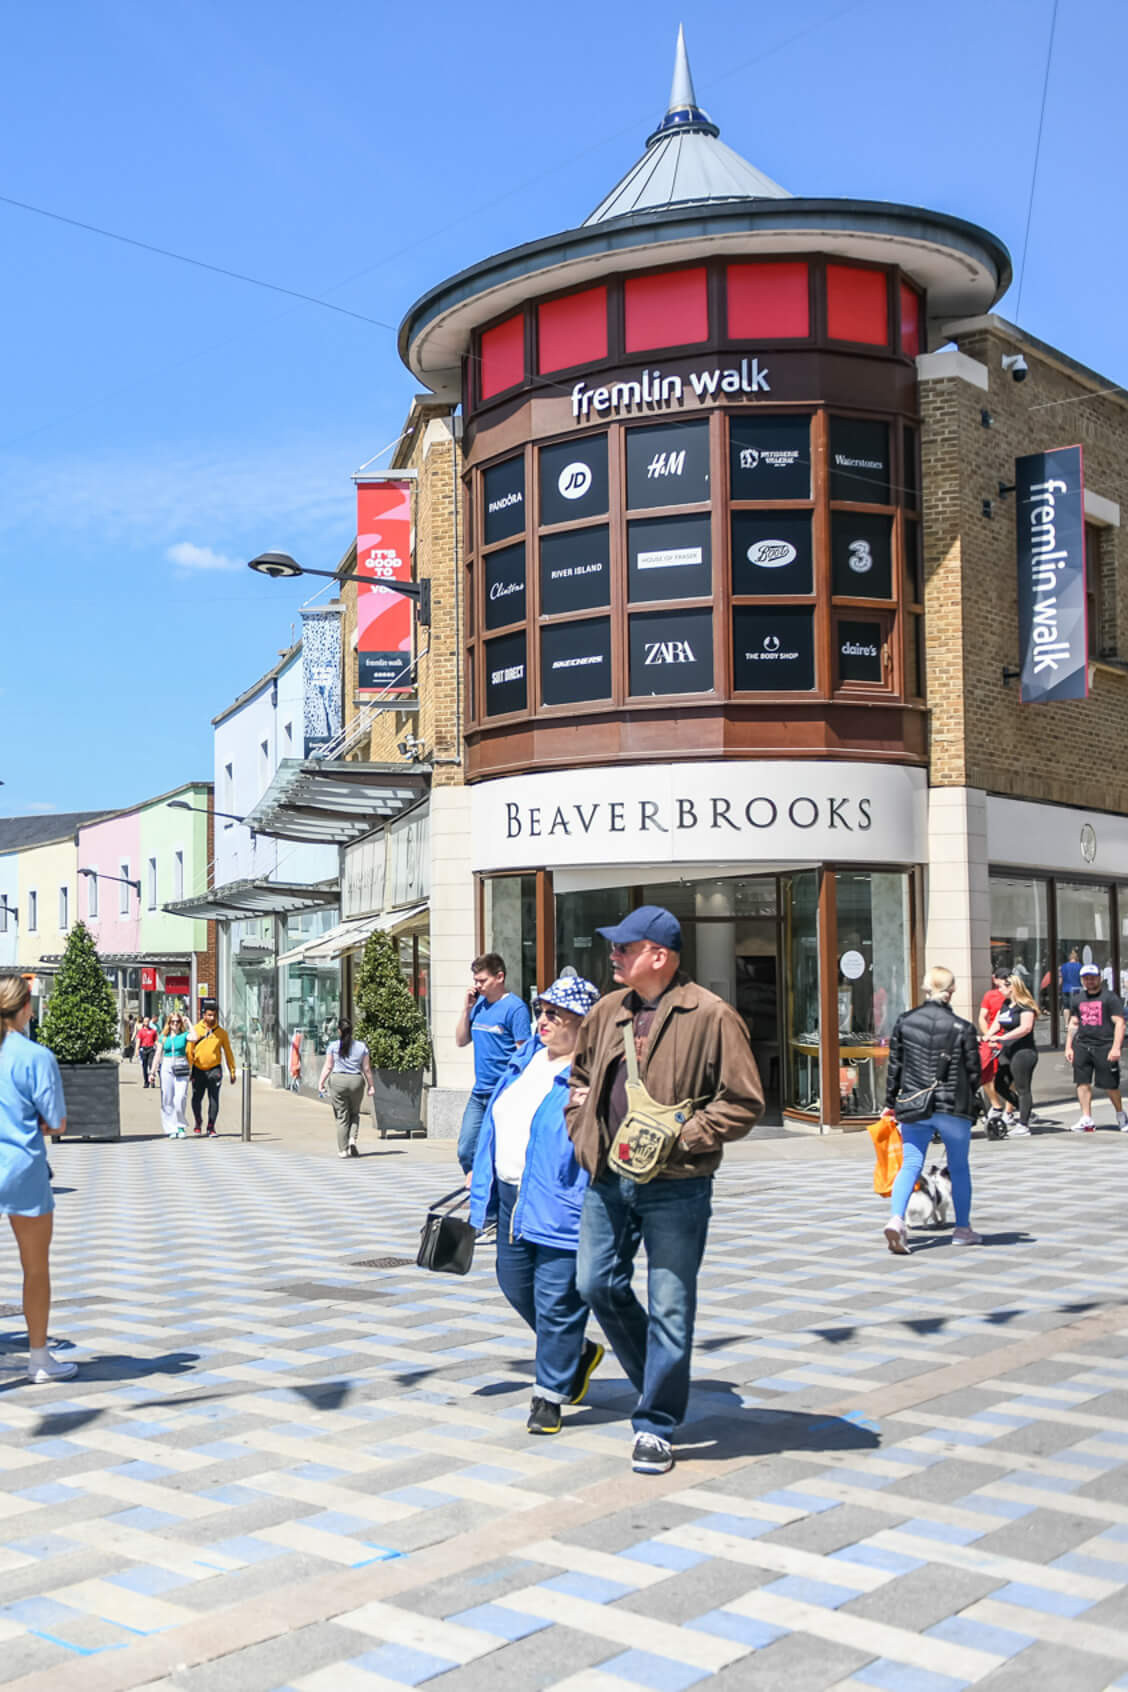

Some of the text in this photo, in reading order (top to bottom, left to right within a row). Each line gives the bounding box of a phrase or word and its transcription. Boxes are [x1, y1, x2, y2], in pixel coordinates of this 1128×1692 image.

[571, 358, 771, 416] fremlin walk
[648, 451, 686, 478] H&M
[835, 454, 883, 469] Waterstones
[564, 471, 586, 491] JD
[370, 549, 396, 559] IT'S
[755, 544, 790, 562] Boots
[365, 558, 402, 567] GOOD
[375, 567, 393, 576] TO
[551, 563, 603, 579] RIVER ISLAND
[1030, 479, 1070, 674] fremlin walk
[644, 640, 696, 665] ZARA
[841, 641, 877, 657] claire's
[505, 797, 873, 839] BEAVERBROOKS
